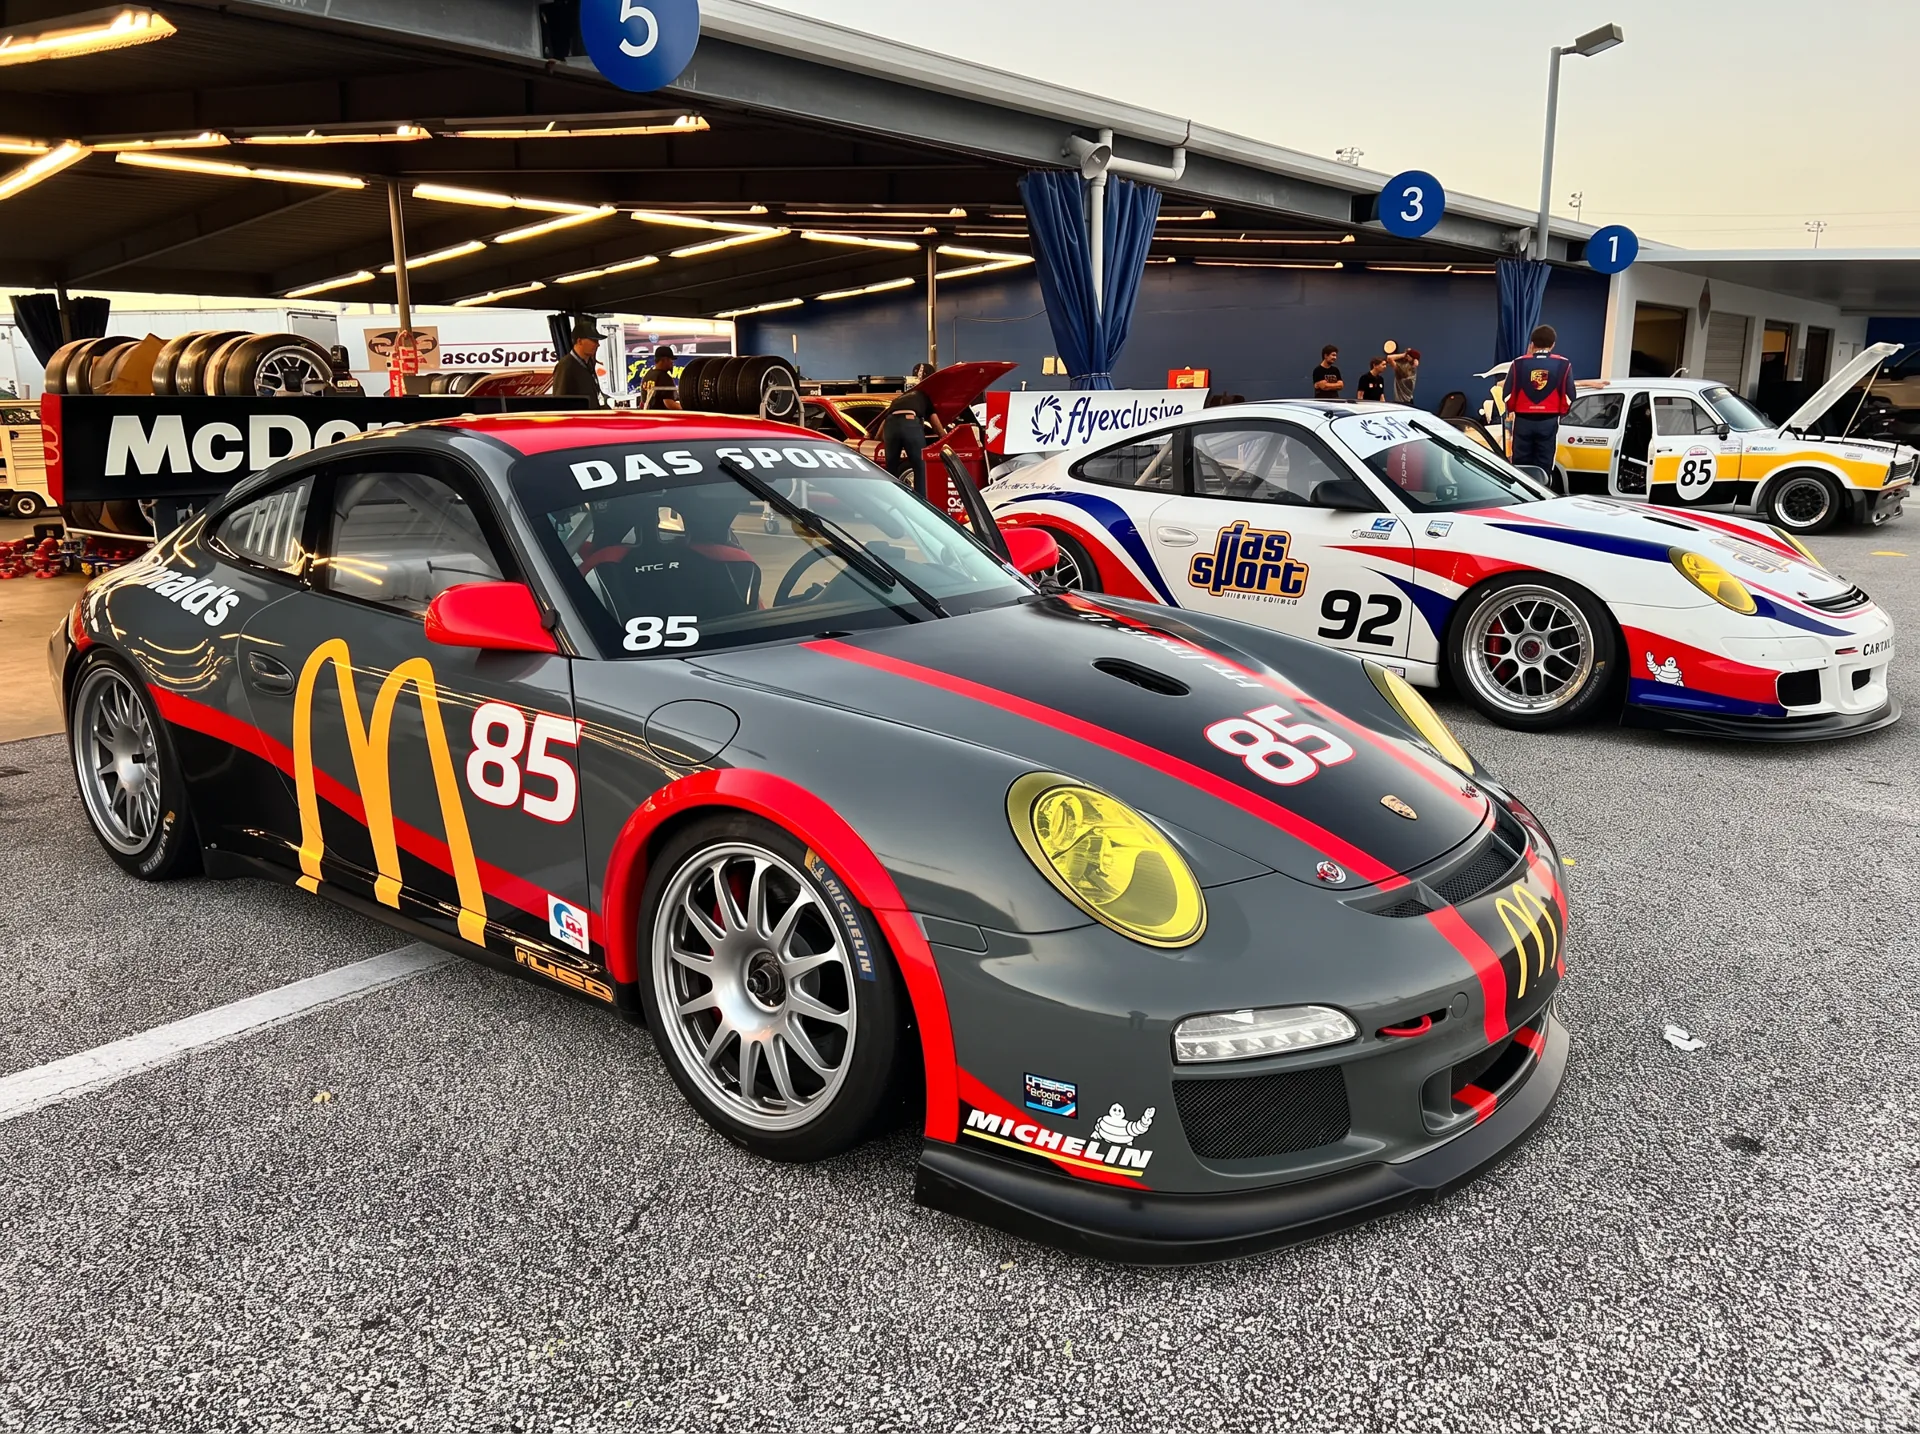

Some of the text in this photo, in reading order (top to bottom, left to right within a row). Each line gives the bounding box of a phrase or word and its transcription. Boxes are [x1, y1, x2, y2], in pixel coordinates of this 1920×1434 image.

[618, 0, 659, 58] 5
[1400, 186, 1424, 222] 3
[1608, 235, 1619, 263] 1
[569, 446, 871, 491] DAS SPORT
[1680, 458, 1713, 487] 85
[635, 561, 680, 573] HTC R
[1191, 556, 1305, 592] sport
[622, 614, 700, 652] 85
[1317, 589, 1403, 647] 92
[466, 699, 583, 825] 85
[1203, 703, 1356, 787] 85
[825, 878, 873, 974] MICHELIN
[966, 1109, 1153, 1169] MICHELIN
